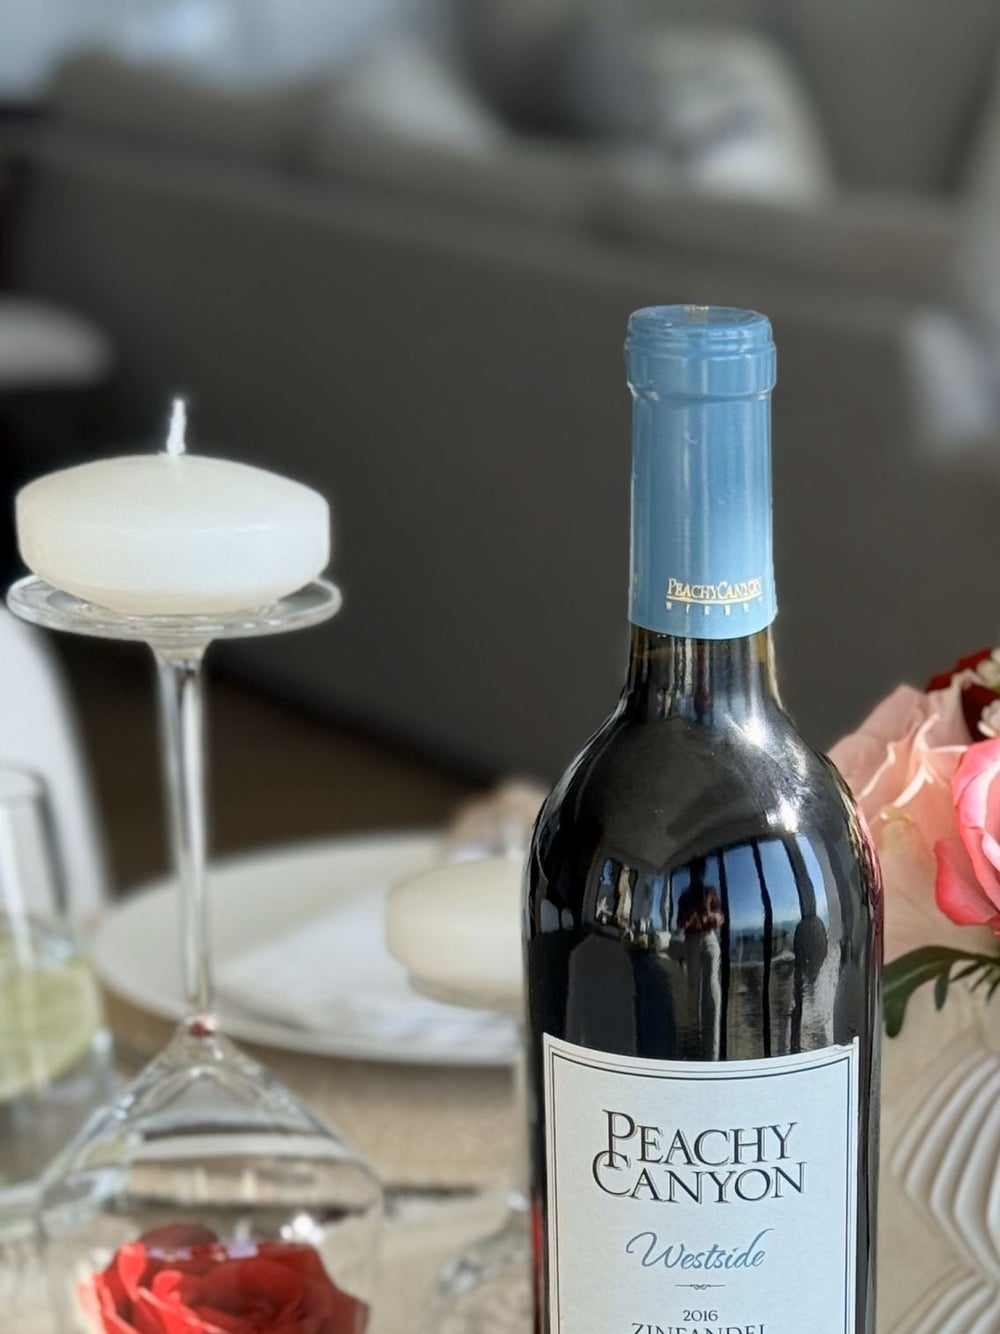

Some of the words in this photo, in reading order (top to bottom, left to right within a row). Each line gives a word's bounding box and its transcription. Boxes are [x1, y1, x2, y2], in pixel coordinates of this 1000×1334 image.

[602, 1109, 798, 1170] PEACHY
[592, 1150, 808, 1204] CANYON
[625, 1228, 775, 1270] Westside
[682, 1309, 719, 1322] 2016
